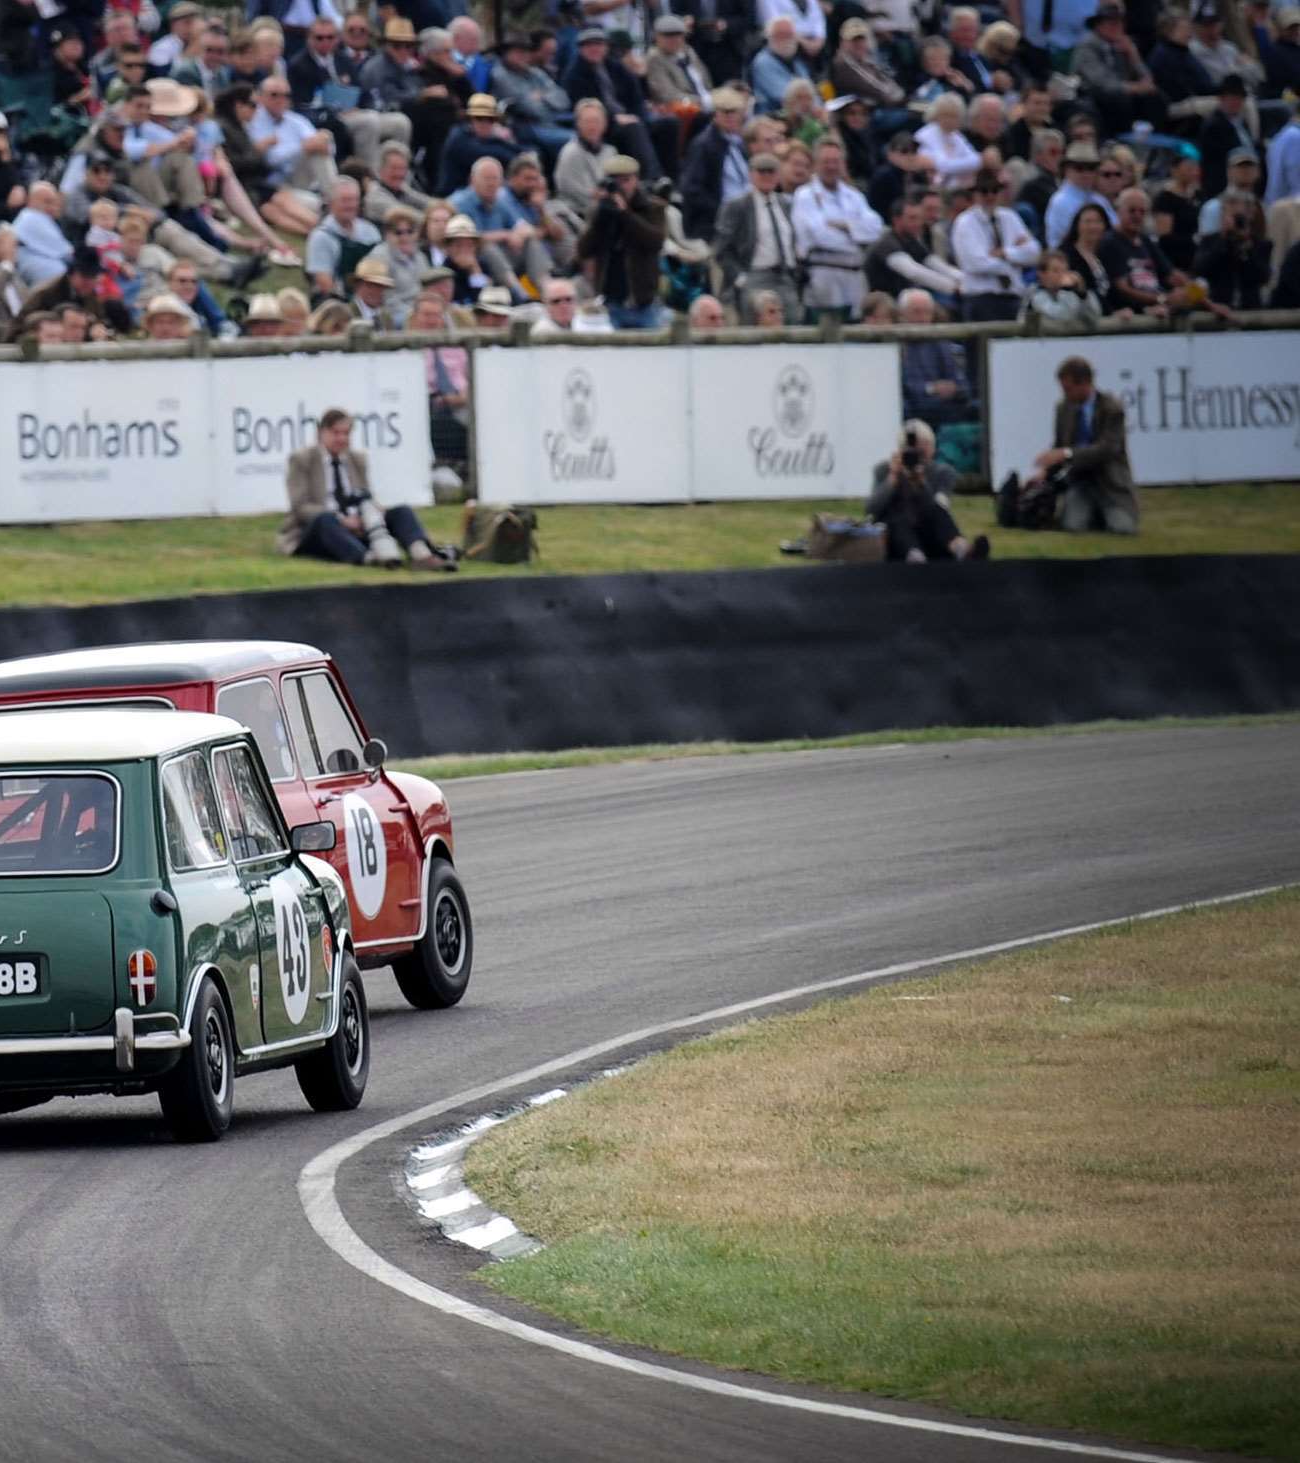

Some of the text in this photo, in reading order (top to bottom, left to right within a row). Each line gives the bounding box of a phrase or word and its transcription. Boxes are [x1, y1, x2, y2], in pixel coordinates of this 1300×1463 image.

[18, 408, 181, 460] Bonhams
[232, 400, 402, 454] Bonhms
[350, 807, 378, 878] 18
[14, 930, 28, 945] S
